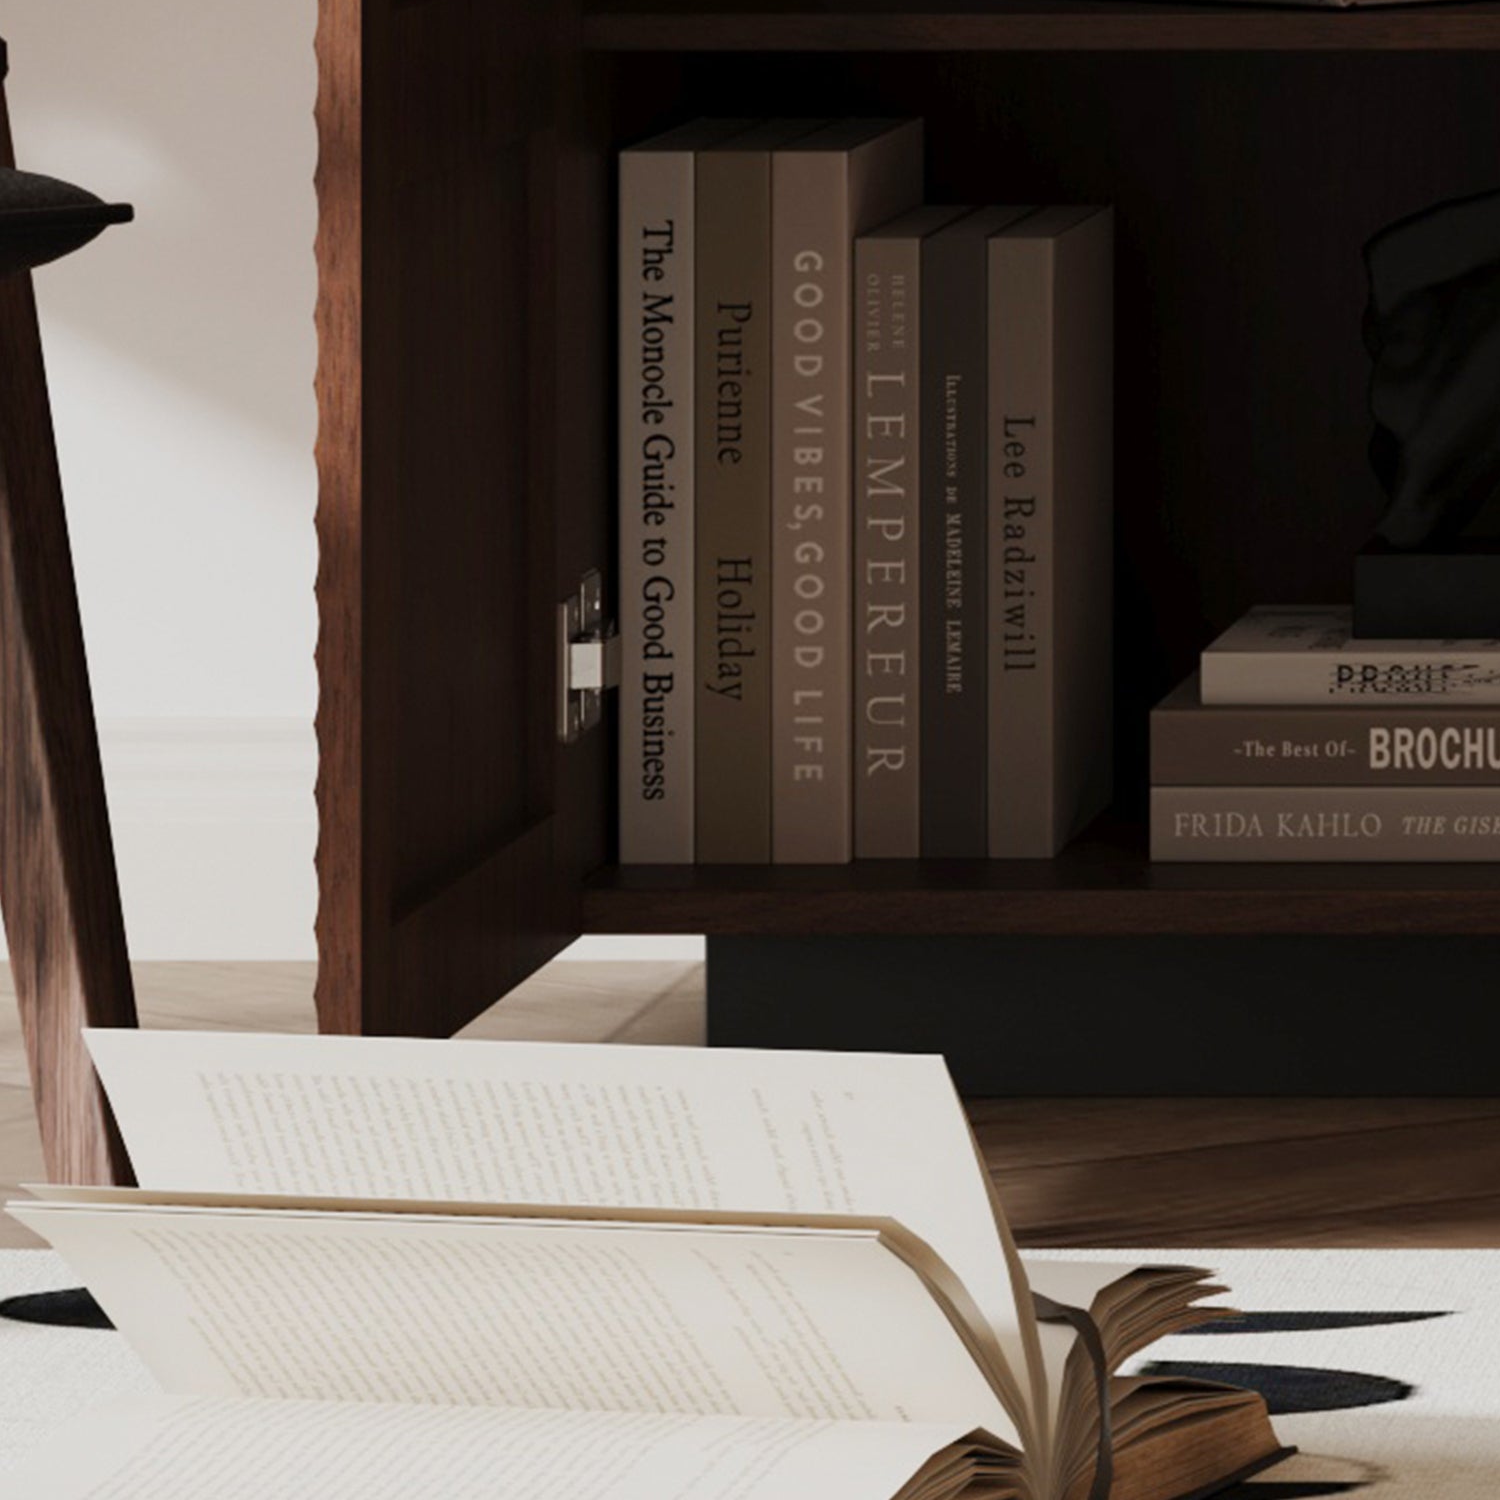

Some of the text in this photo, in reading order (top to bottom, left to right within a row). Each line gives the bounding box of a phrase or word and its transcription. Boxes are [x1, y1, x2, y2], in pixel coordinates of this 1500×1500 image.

[793, 250, 825, 377] GOOD
[641, 219, 675, 801] The Monocle Guide to Good Business
[705, 302, 756, 701] Purienne Holiday
[1003, 416, 1037, 671] Lee Radziwill
[866, 371, 906, 775] LEMPEREUR
[945, 619, 963, 693] LEMAIRE
[792, 689, 824, 781] LIFE
[1281, 740, 1319, 758] Best
[1174, 811, 1264, 838] FRIDA
[1277, 811, 1383, 838] KAHLO
[1402, 815, 1447, 835] THE
